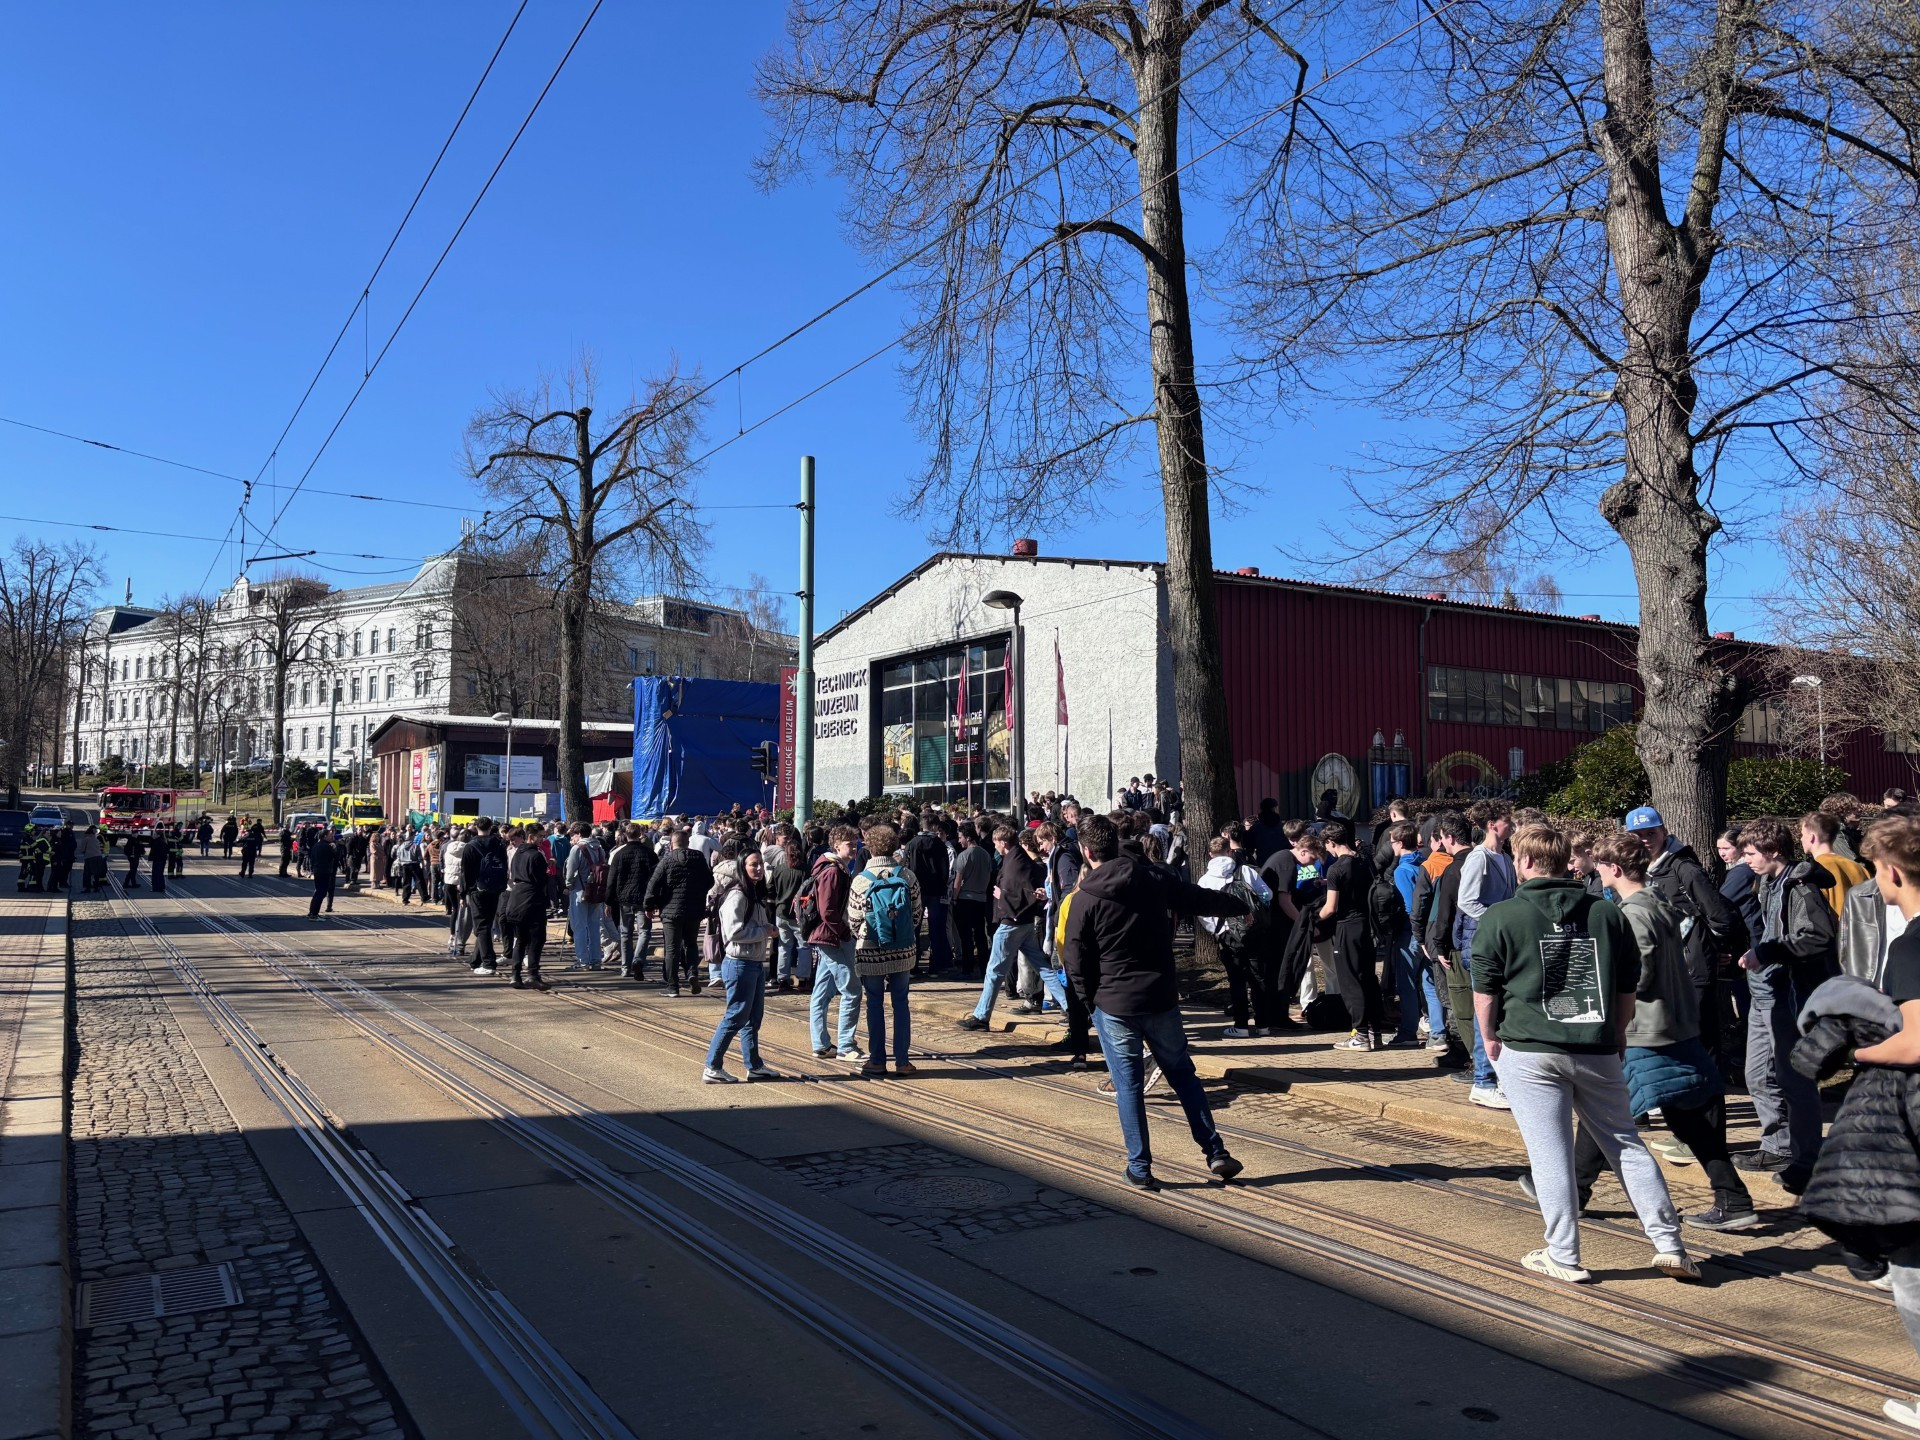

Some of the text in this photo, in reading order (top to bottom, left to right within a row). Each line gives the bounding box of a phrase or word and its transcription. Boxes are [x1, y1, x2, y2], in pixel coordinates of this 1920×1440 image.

[814, 693, 859, 717] MUZEUM
[814, 718, 858, 739] LIBEREC
[784, 699, 794, 804] TECHNICKÉ MUZEUM
